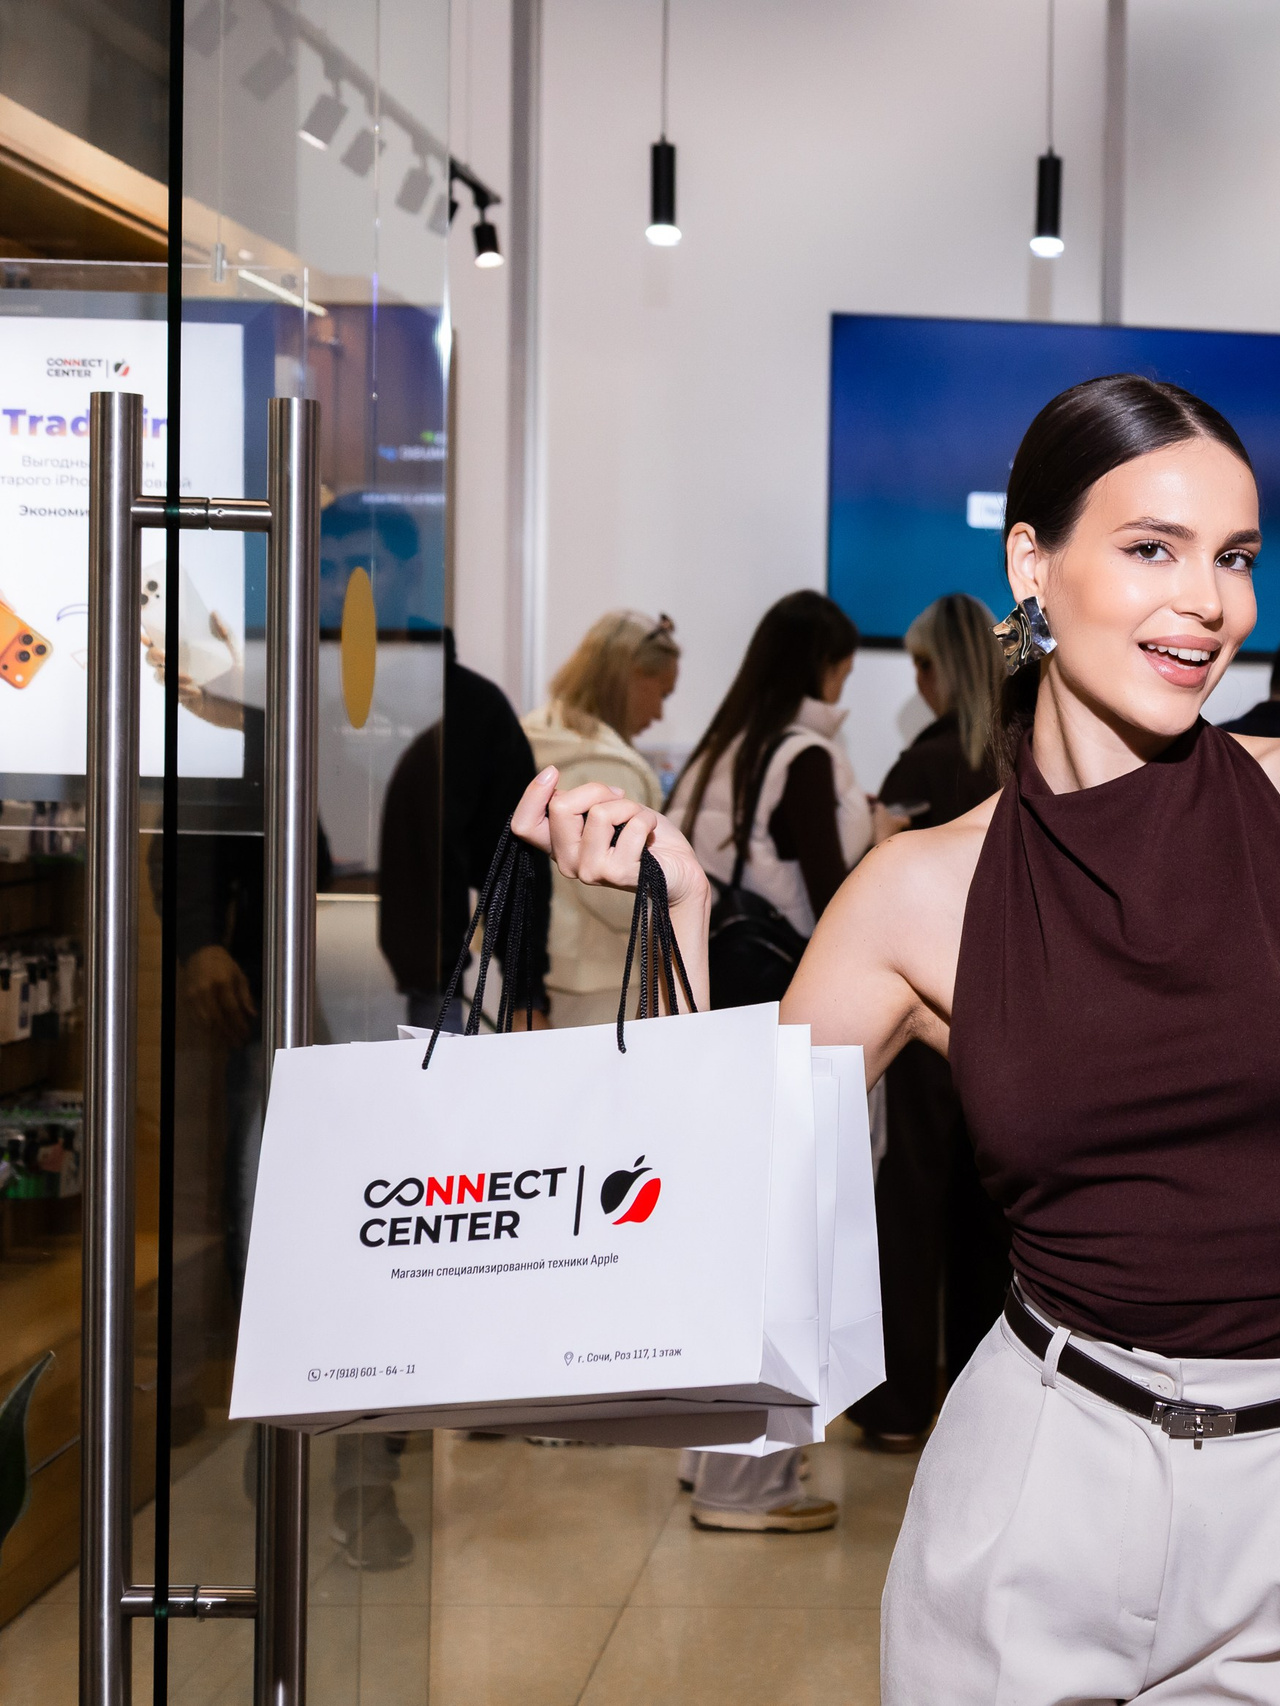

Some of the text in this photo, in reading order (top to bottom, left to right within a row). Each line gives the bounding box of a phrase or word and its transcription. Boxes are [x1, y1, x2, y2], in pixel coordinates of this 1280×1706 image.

[47, 358, 102, 367] CONNECT
[47, 368, 91, 378] CENTER
[22, 455, 90, 469] Выгодны
[0, 475, 50, 487] тарого
[55, 474, 90, 487] iPho
[19, 505, 90, 518] Экономи
[363, 1166, 567, 1209] CONNECT
[359, 1210, 521, 1248] CENTER
[390, 1252, 619, 1280] Магазин специализированной техники Apple
[586, 1352, 612, 1363] Сочи,
[614, 1350, 631, 1361] Роз
[633, 1349, 650, 1360] 117,
[659, 1347, 682, 1357] этаж
[336, 1367, 359, 1380] (918)
[360, 1367, 377, 1377] 601
[385, 1366, 398, 1376] 64
[406, 1364, 416, 1375] 11
